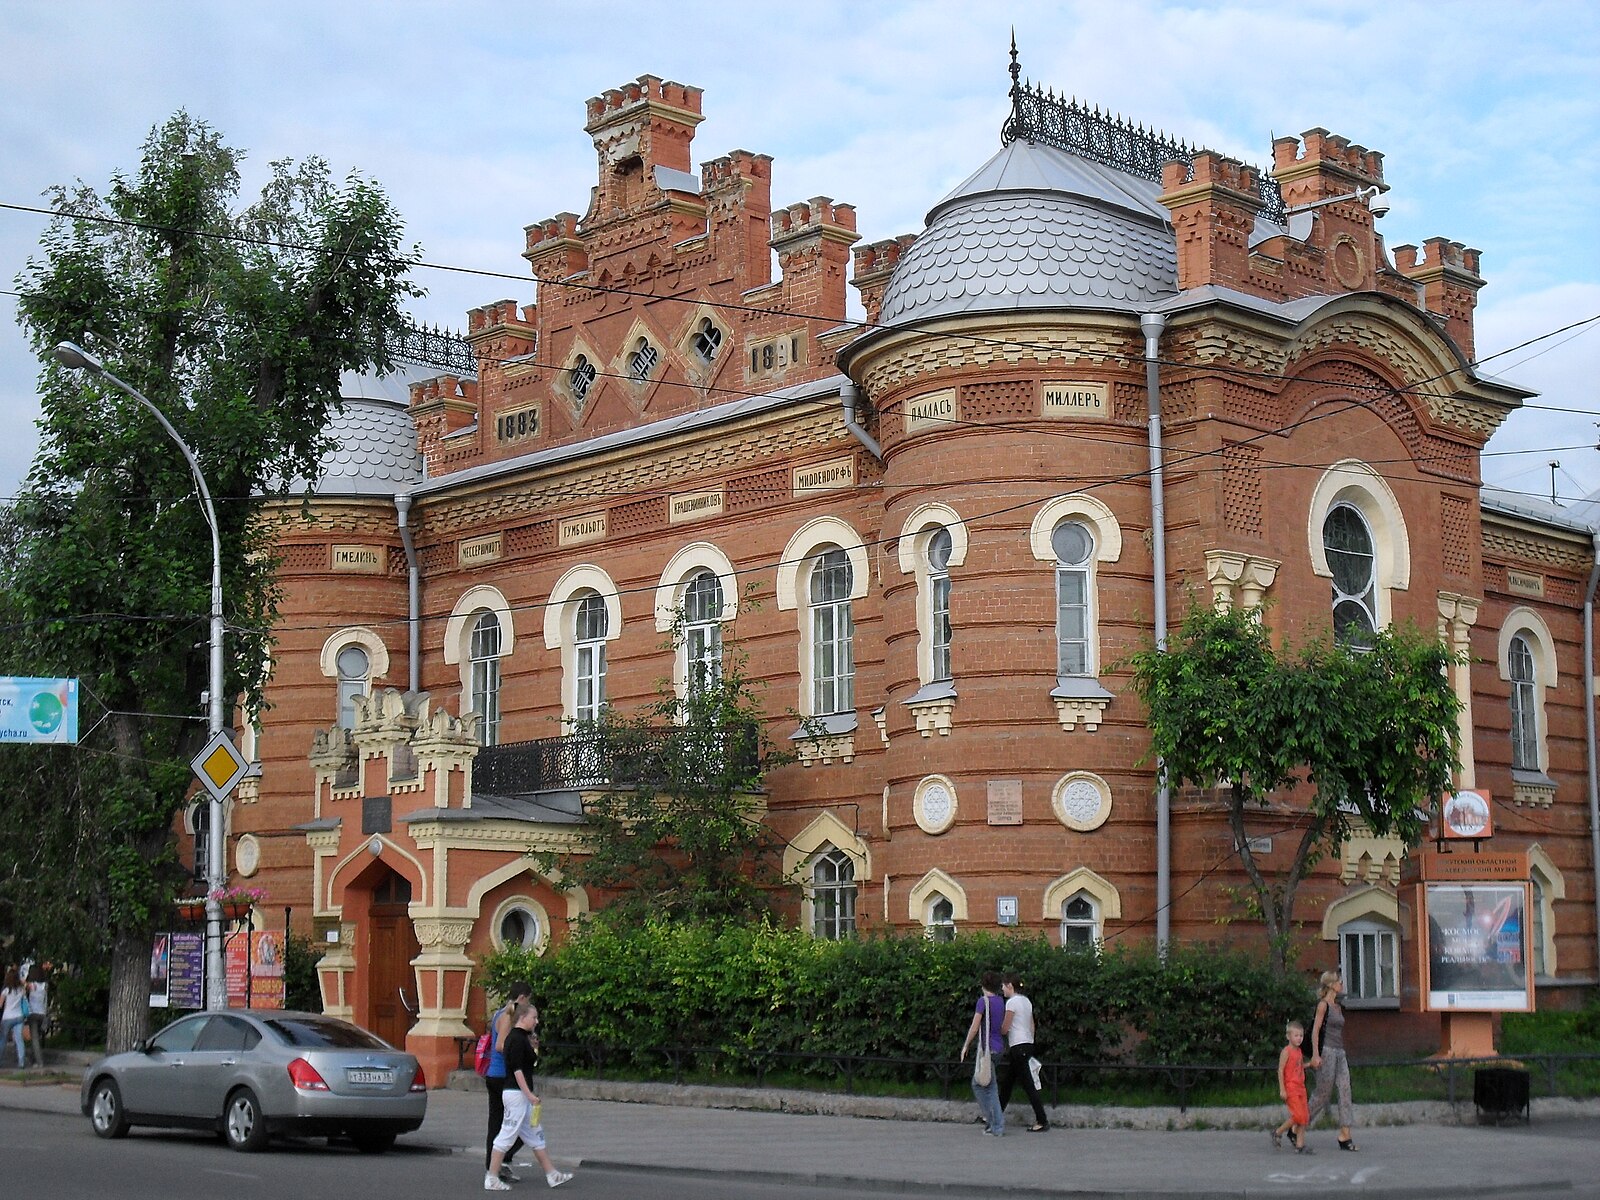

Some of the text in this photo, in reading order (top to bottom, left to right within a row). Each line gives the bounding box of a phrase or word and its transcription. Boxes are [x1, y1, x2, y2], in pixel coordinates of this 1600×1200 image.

[752, 338, 799, 373] 1891
[911, 399, 952, 422] ПАЛЛАСЪ
[1046, 391, 1101, 407] МИЛЛЕРЪ
[498, 409, 538, 440] 1883
[336, 551, 378, 564] ГМЕЛИНЪ
